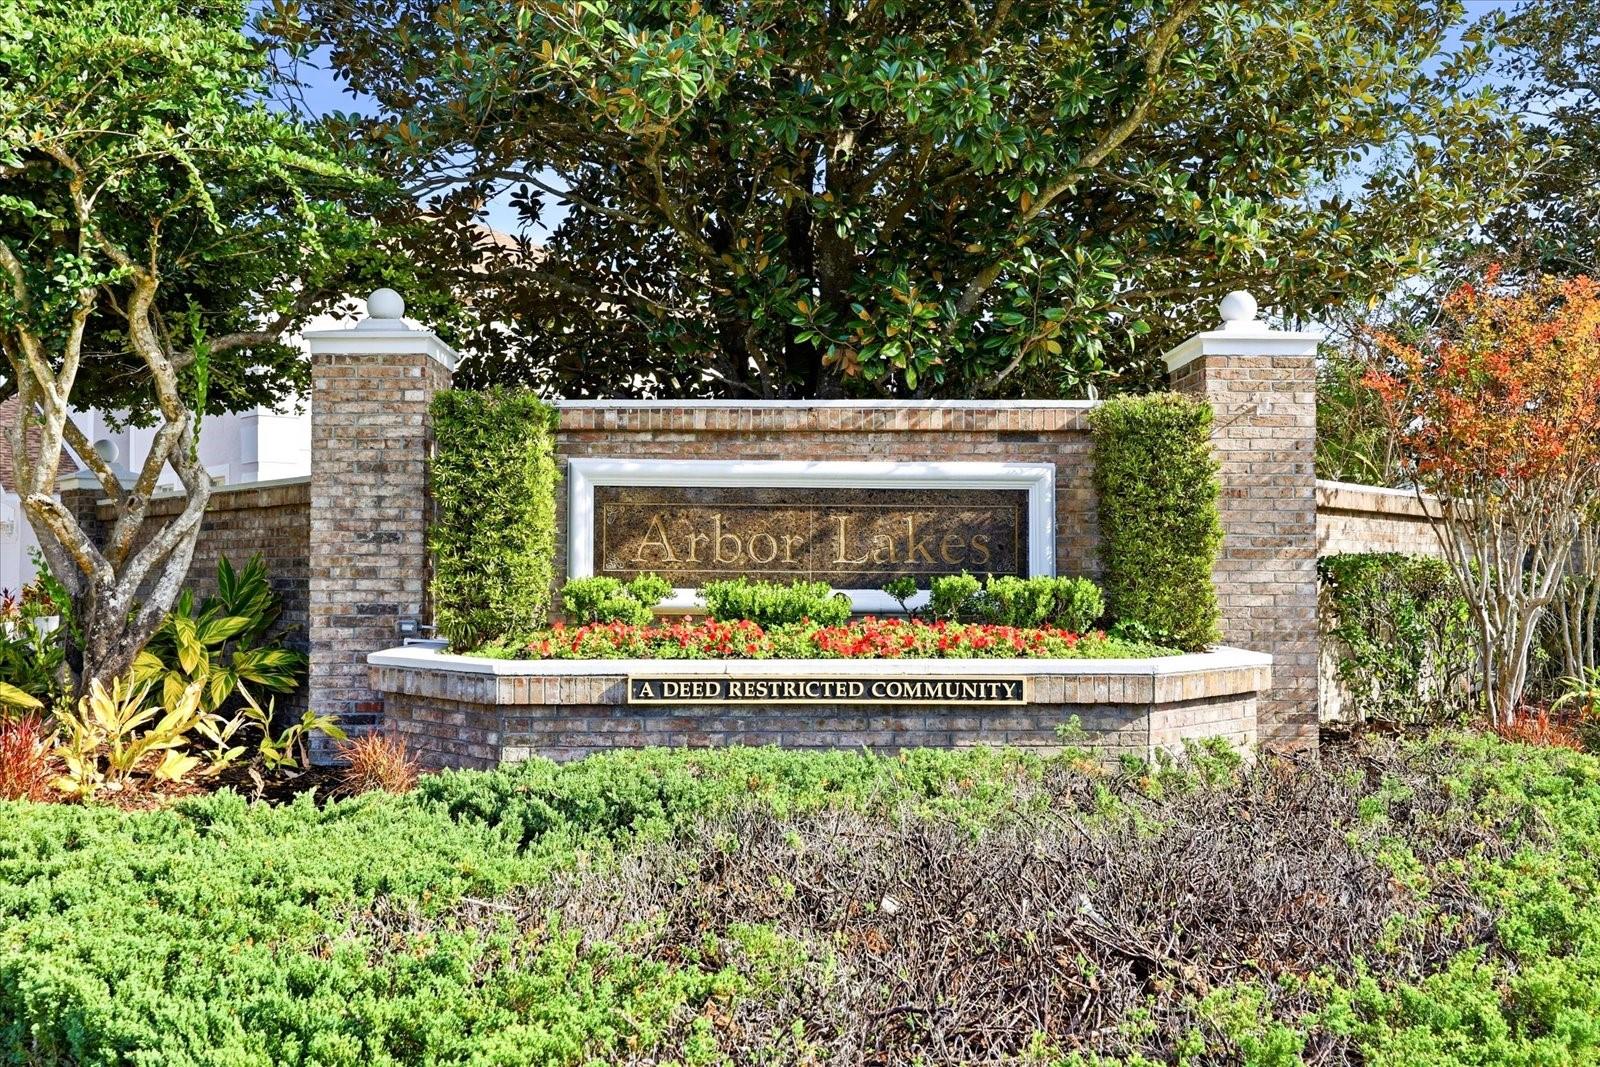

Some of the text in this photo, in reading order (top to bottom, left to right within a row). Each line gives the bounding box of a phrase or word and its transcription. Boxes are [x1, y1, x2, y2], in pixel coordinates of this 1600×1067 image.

[631, 512, 994, 565] Arbor Lakes
[638, 681, 1017, 698] A DEED RESTRICTED COMMUNITY
